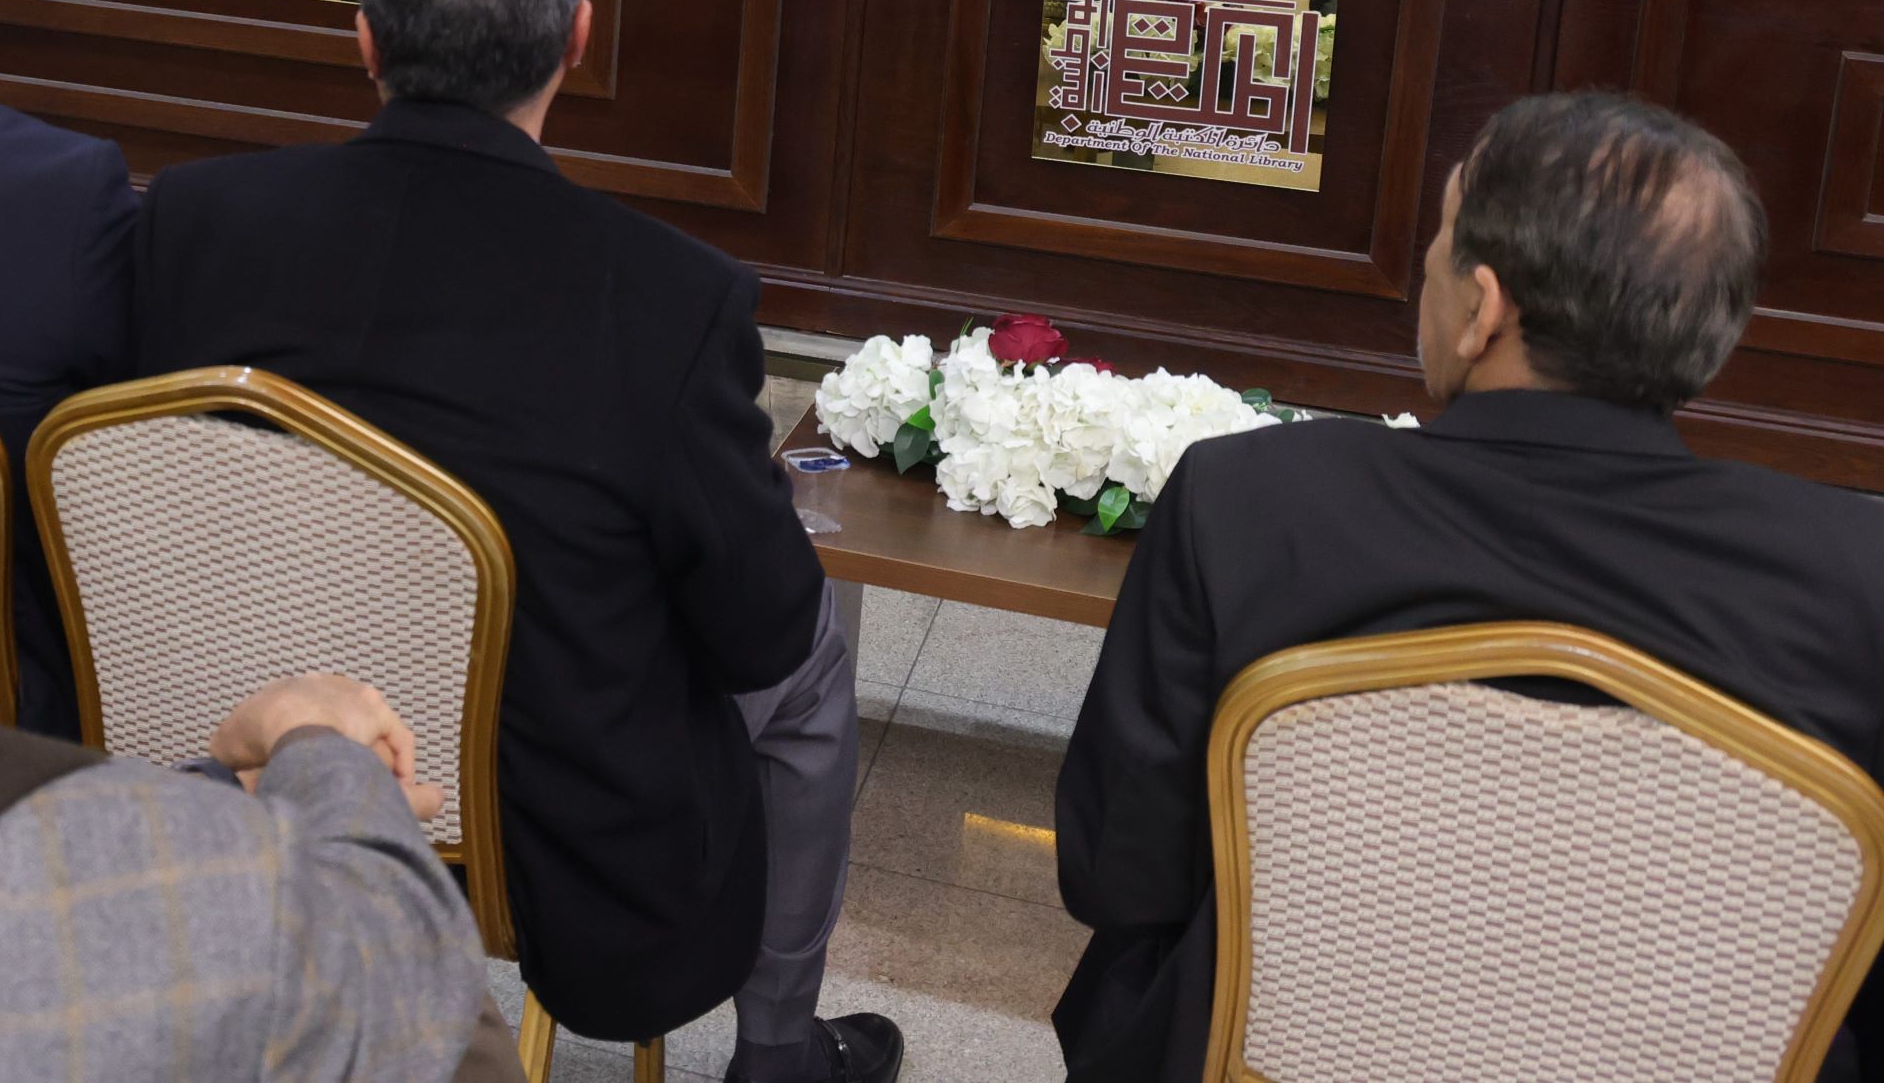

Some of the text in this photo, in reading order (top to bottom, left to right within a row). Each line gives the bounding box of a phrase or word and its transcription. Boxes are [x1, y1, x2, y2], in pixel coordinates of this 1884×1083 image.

[1044, 131, 1305, 173] Department Of The National Library
[1085, 118, 1282, 153] دائرة المكتبة الوطنية
